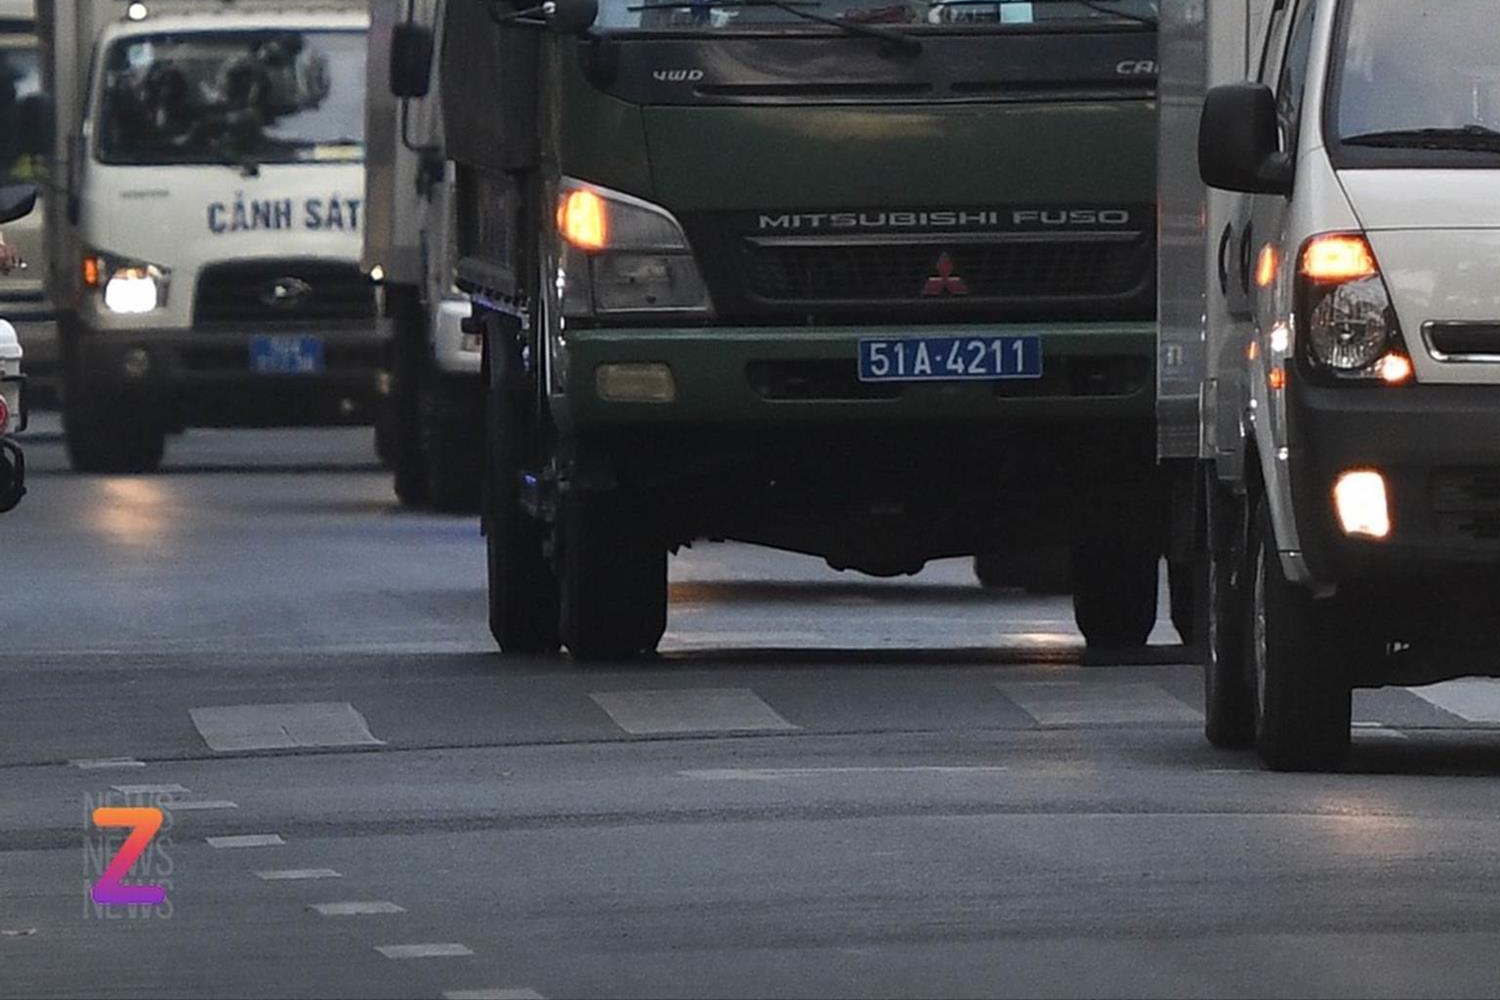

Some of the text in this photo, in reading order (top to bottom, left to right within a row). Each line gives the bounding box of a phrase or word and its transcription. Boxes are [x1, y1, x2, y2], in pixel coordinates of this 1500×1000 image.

[1116, 60, 1159, 74] CA
[653, 70, 704, 81] 4WD
[759, 209, 1130, 229] MITSUBISHI FUSO
